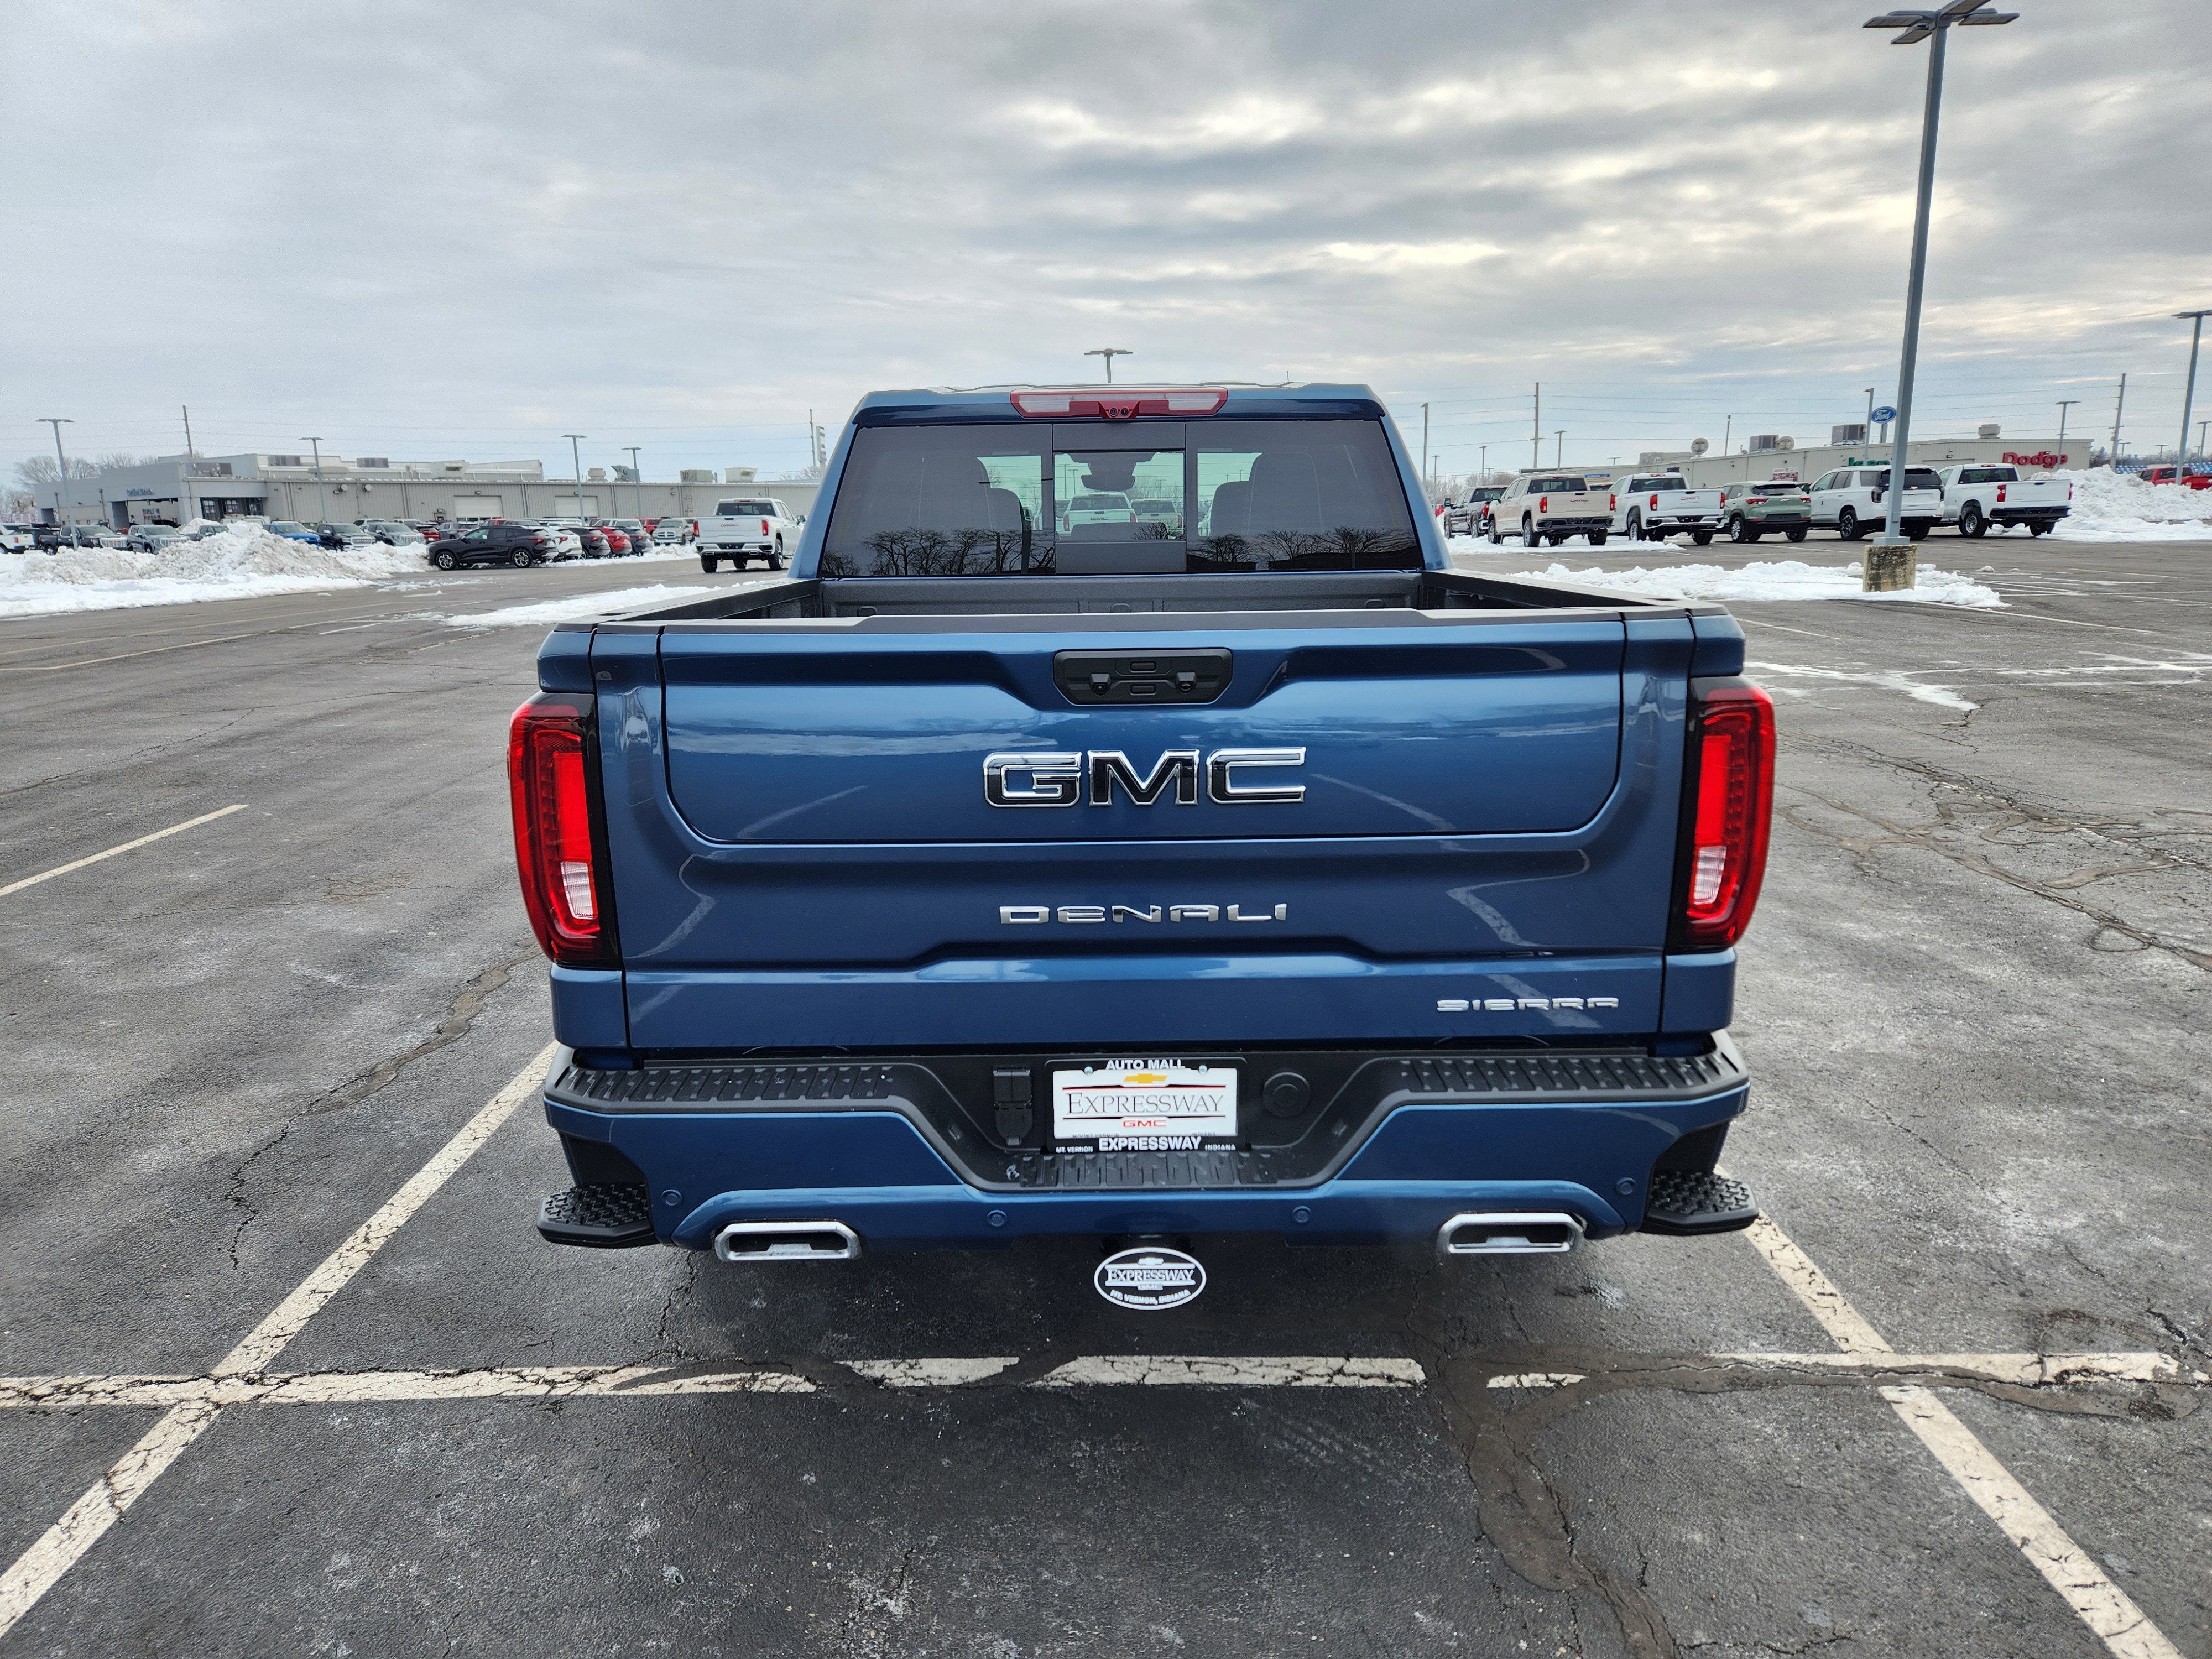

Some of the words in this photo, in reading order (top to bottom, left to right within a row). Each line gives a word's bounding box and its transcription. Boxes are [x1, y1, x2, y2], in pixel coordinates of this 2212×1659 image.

[1874, 409, 1891, 420] Ford
[2002, 451, 2068, 468] Dodge
[983, 747, 1306, 807] GMC
[999, 903, 1287, 924] DENALI
[1437, 997, 1619, 1011] SIERRA
[1106, 1060, 1145, 1070] AUTO
[1147, 1058, 1186, 1070] MALL
[1065, 1092, 1224, 1114] EXPRESSWAY
[1099, 1136, 1202, 1151] EXPRESSWAY
[1107, 1269, 1194, 1281] EXPRESSWAY
[1158, 1289, 1191, 1303] INDIANA
